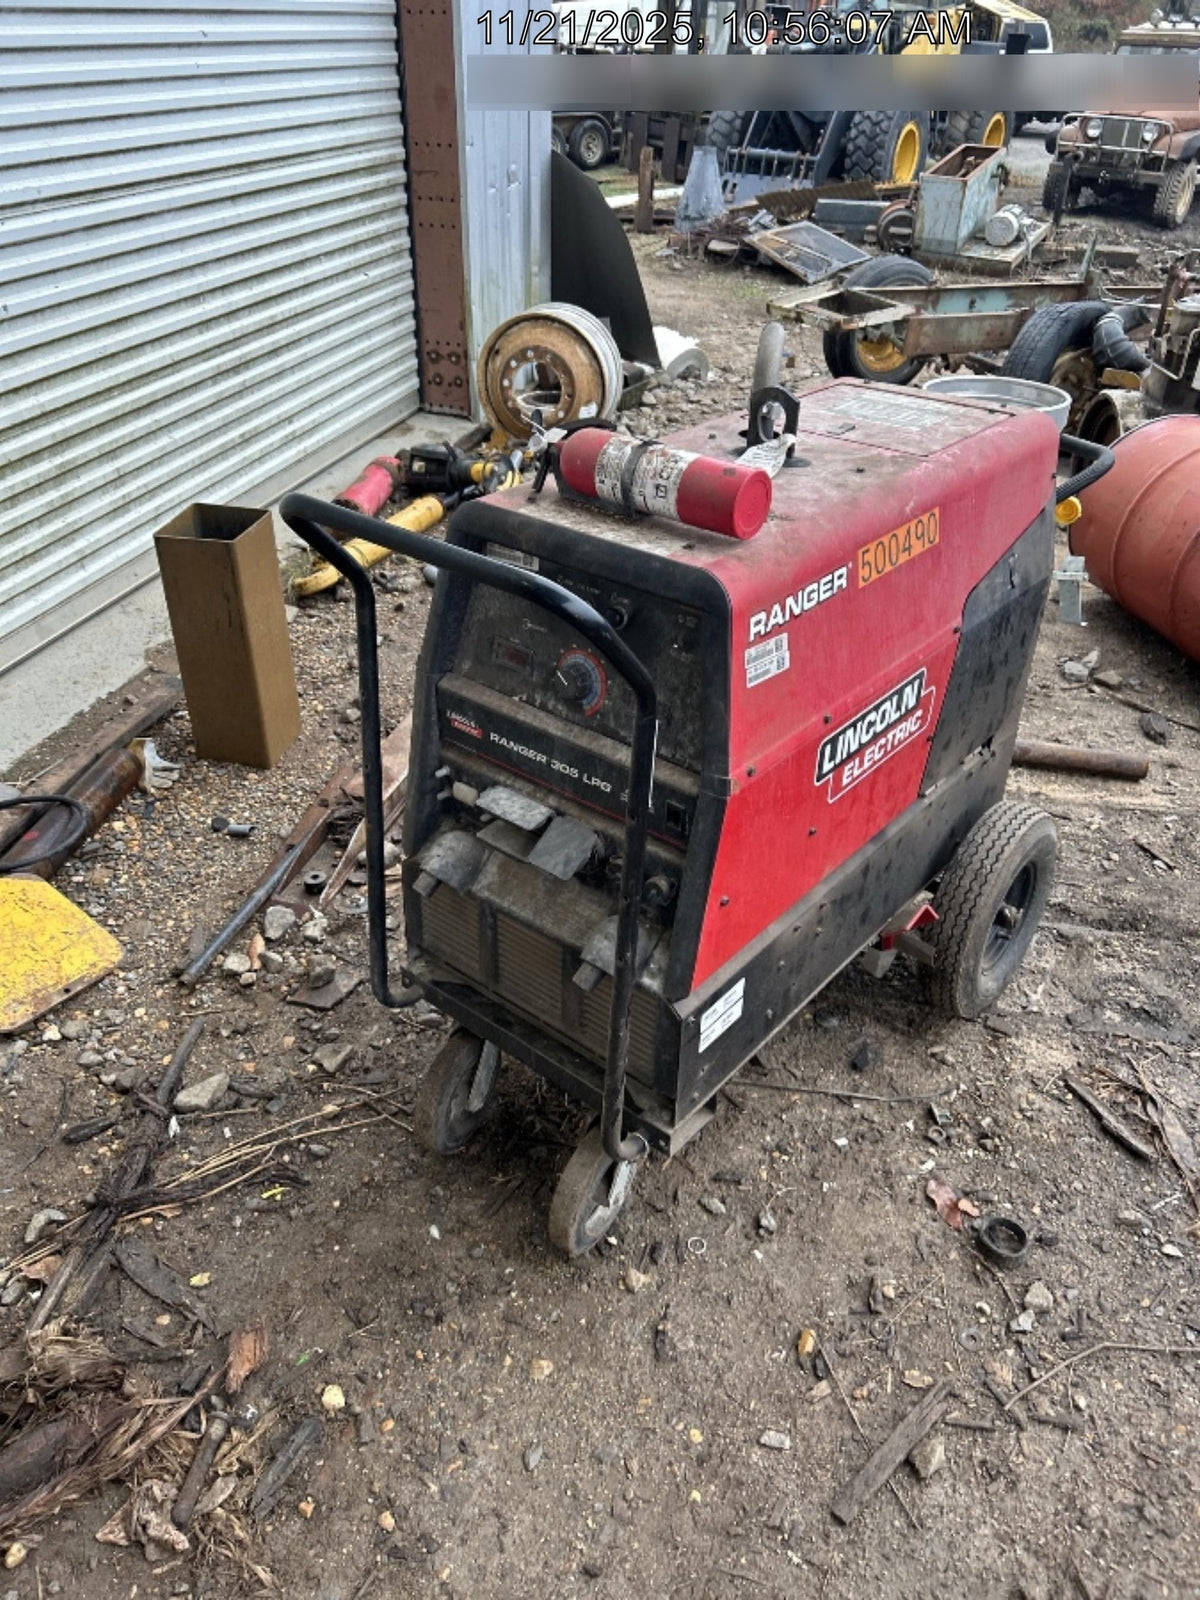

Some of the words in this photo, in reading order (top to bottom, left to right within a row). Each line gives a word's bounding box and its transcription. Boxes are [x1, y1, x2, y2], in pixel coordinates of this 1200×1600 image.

[860, 511, 939, 584] 500490
[747, 568, 846, 642] RANGER
[489, 731, 548, 766] RANGER
[549, 758, 580, 781] 305
[582, 772, 613, 794] LPG
[820, 683, 922, 774] LINCOLN
[841, 710, 923, 787] ELECTRIC
